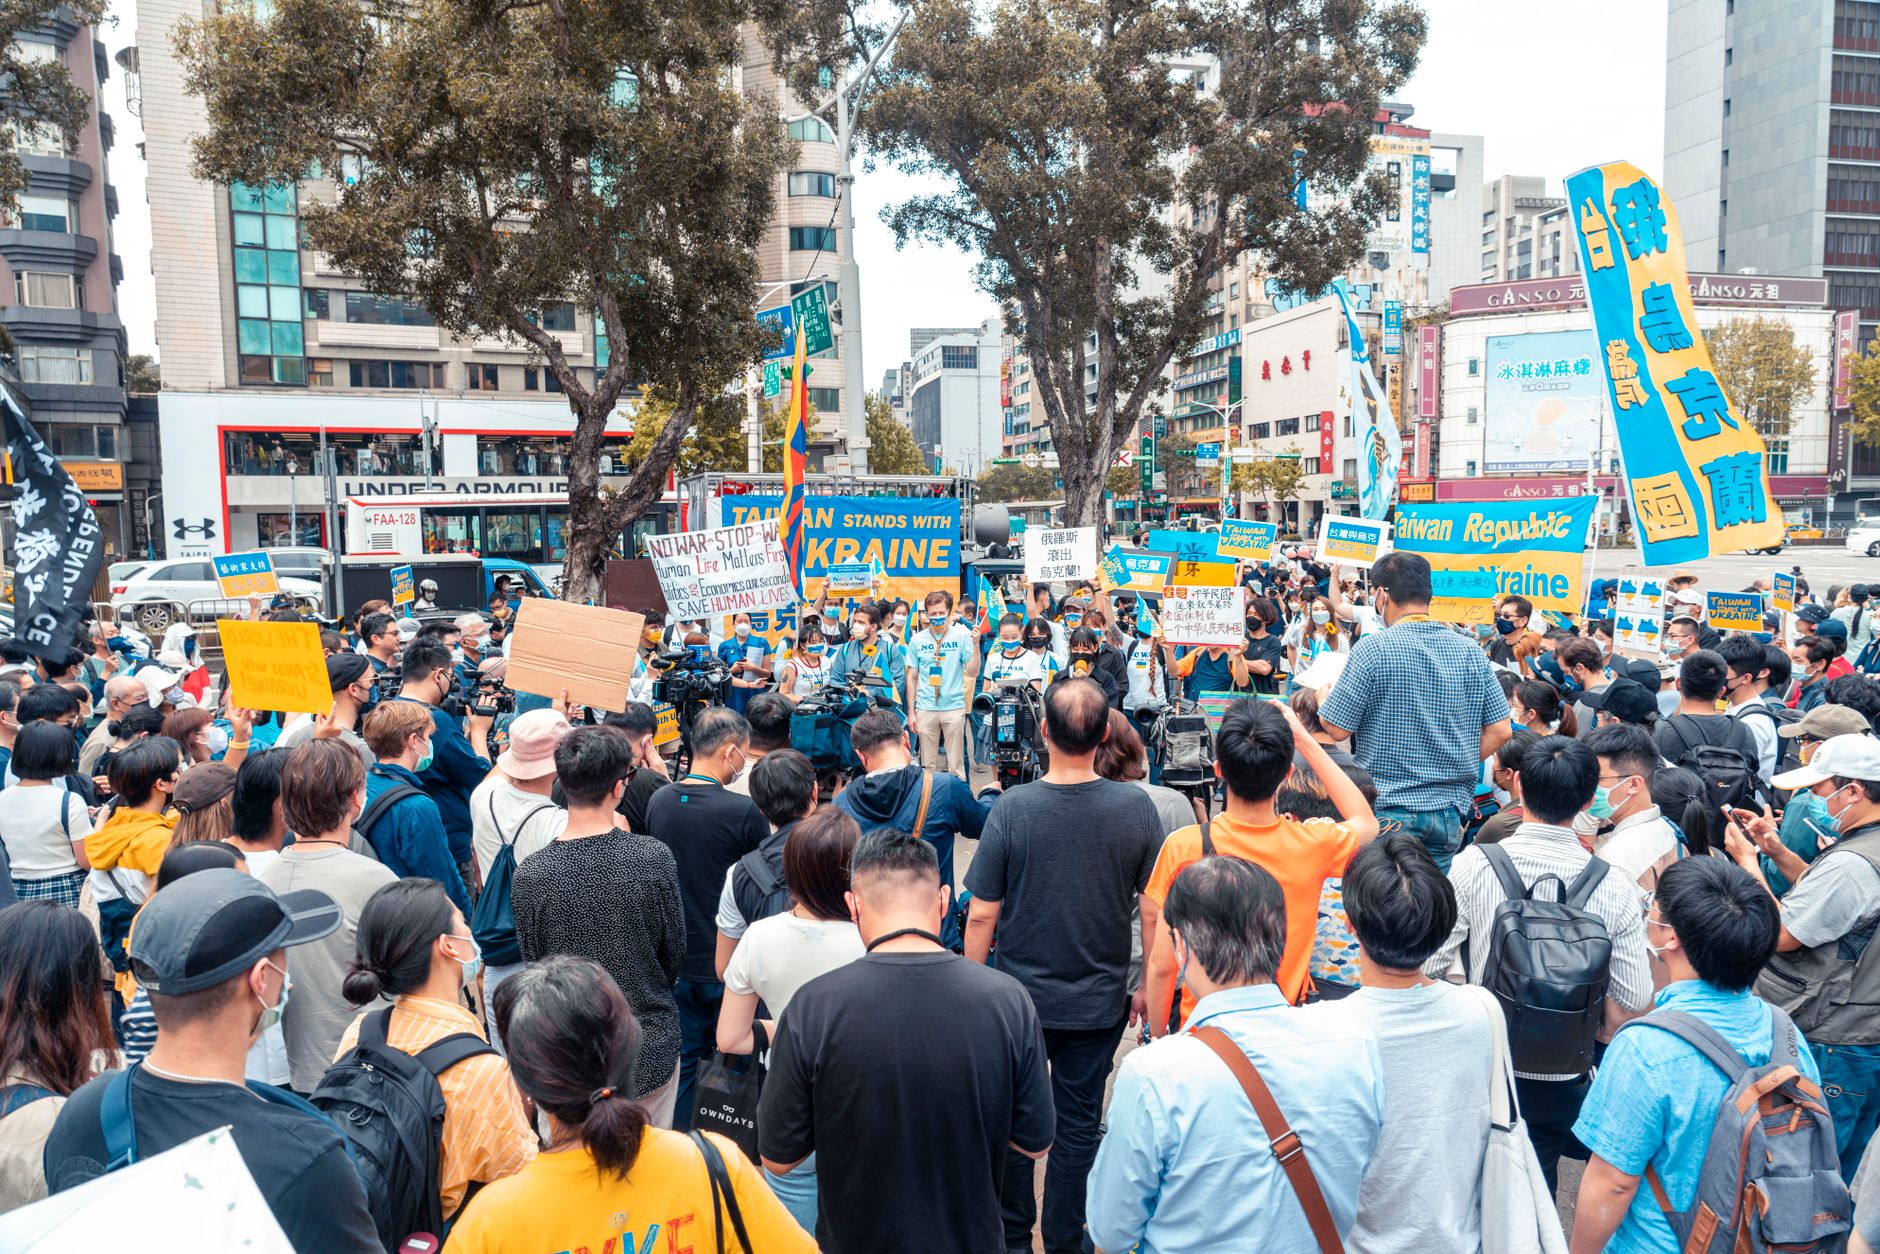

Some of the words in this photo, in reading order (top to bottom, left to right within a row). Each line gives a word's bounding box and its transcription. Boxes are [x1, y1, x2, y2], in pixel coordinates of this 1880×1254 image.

[1487, 286, 1561, 307] GANSO
[1688, 277, 1746, 298] GANSO
[1750, 283, 1780, 300] 元祖
[1424, 342, 1434, 370] 元祖
[1503, 483, 1547, 497] GANSO
[1551, 484, 1579, 497] 元祖
[373, 513, 416, 525] FAA-128
[842, 514, 907, 529] STANDS
[912, 515, 952, 529] WITH
[1225, 524, 1267, 535] TAIWAN
[1329, 527, 1377, 543] 台灣與烏克
[1394, 511, 1454, 542] Taiwan
[1463, 511, 1572, 549] Republic
[649, 537, 673, 559] NO
[715, 525, 755, 551] STOP
[761, 521, 780, 543] WA
[1041, 530, 1078, 546] 俄羅斯
[1220, 536, 1270, 550] UKRAINE
[722, 548, 765, 571] Matters
[765, 543, 785, 565] Firs
[804, 537, 952, 569] KRAINE
[1047, 547, 1072, 561] 滾出
[1039, 564, 1081, 579] 烏克蘭!
[1125, 558, 1162, 572] 烏克蘭
[698, 577, 745, 597] Economics
[1479, 563, 1570, 600] raine
[677, 598, 711, 618] SAVE
[711, 591, 756, 612] HUMAN
[761, 586, 791, 605] LIVES
[1710, 595, 1752, 607] TAIWAN
[1708, 609, 1759, 621] UKRAINE
[700, 1107, 754, 1129] OWNDAYS
